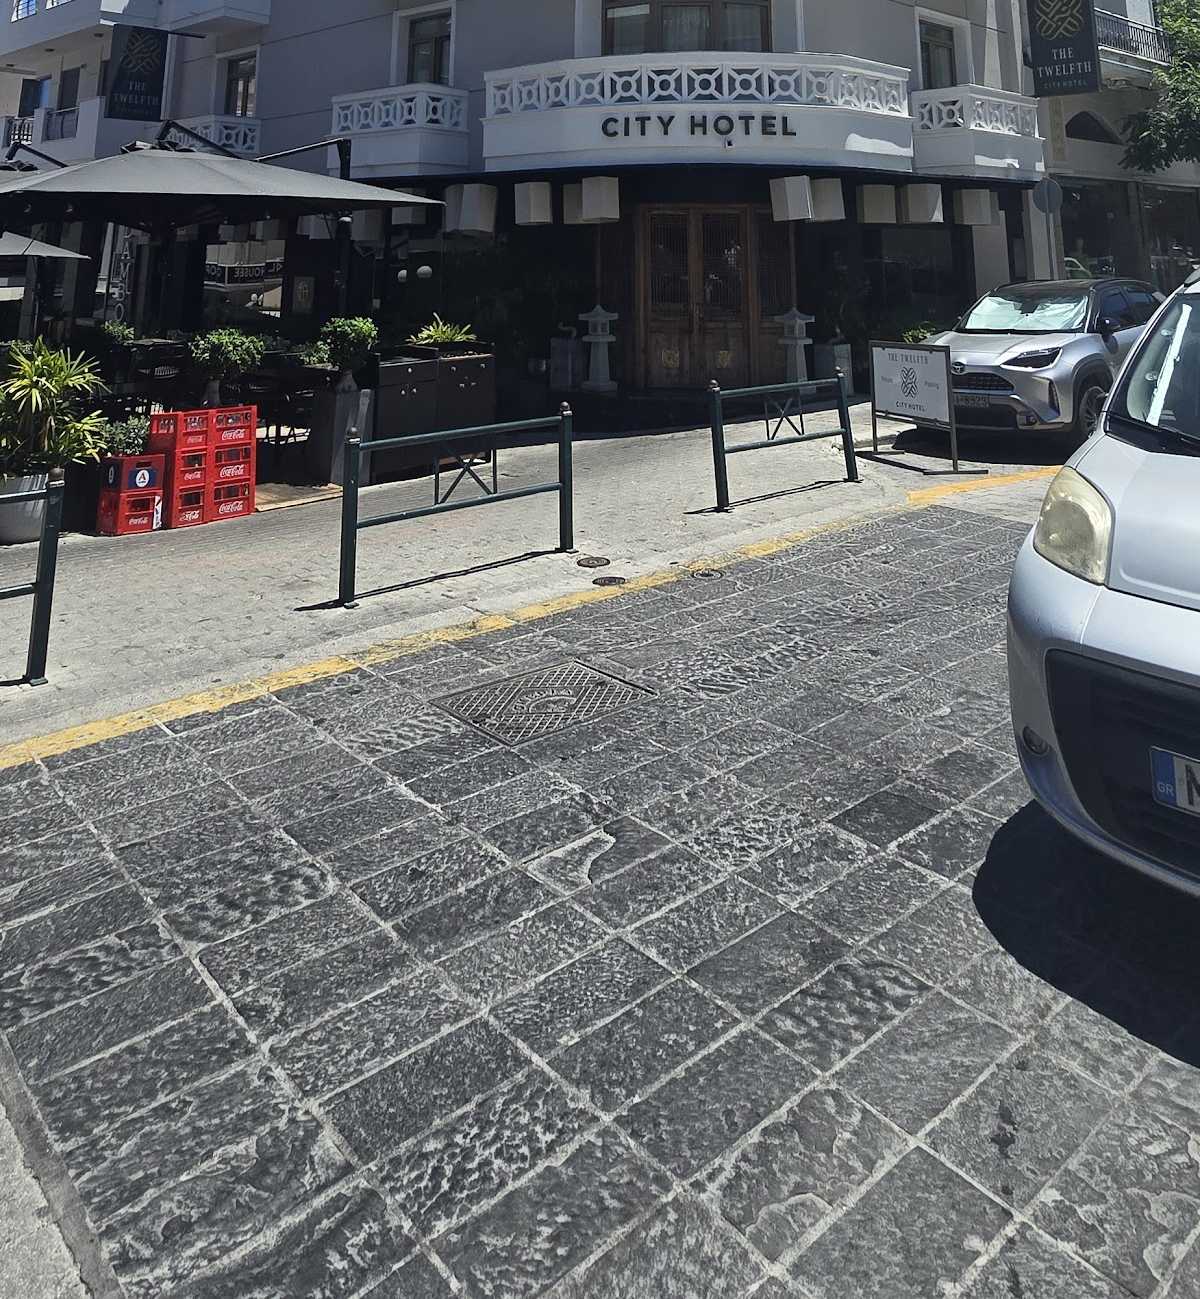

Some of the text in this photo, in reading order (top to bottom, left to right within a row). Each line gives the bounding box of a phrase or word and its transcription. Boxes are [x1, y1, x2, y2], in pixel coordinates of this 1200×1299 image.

[1051, 47, 1074, 60] THE
[1037, 61, 1092, 78] TWELFTH
[129, 81, 147, 92] THE
[1063, 79, 1087, 87] HOTEL
[113, 93, 160, 106] TWELFTH
[601, 114, 797, 138] CITY HOTEL
[888, 353, 929, 365] THE TWELFTH
[895, 401, 926, 412] CITY HOTEL
[1157, 781, 1175, 797] GR
